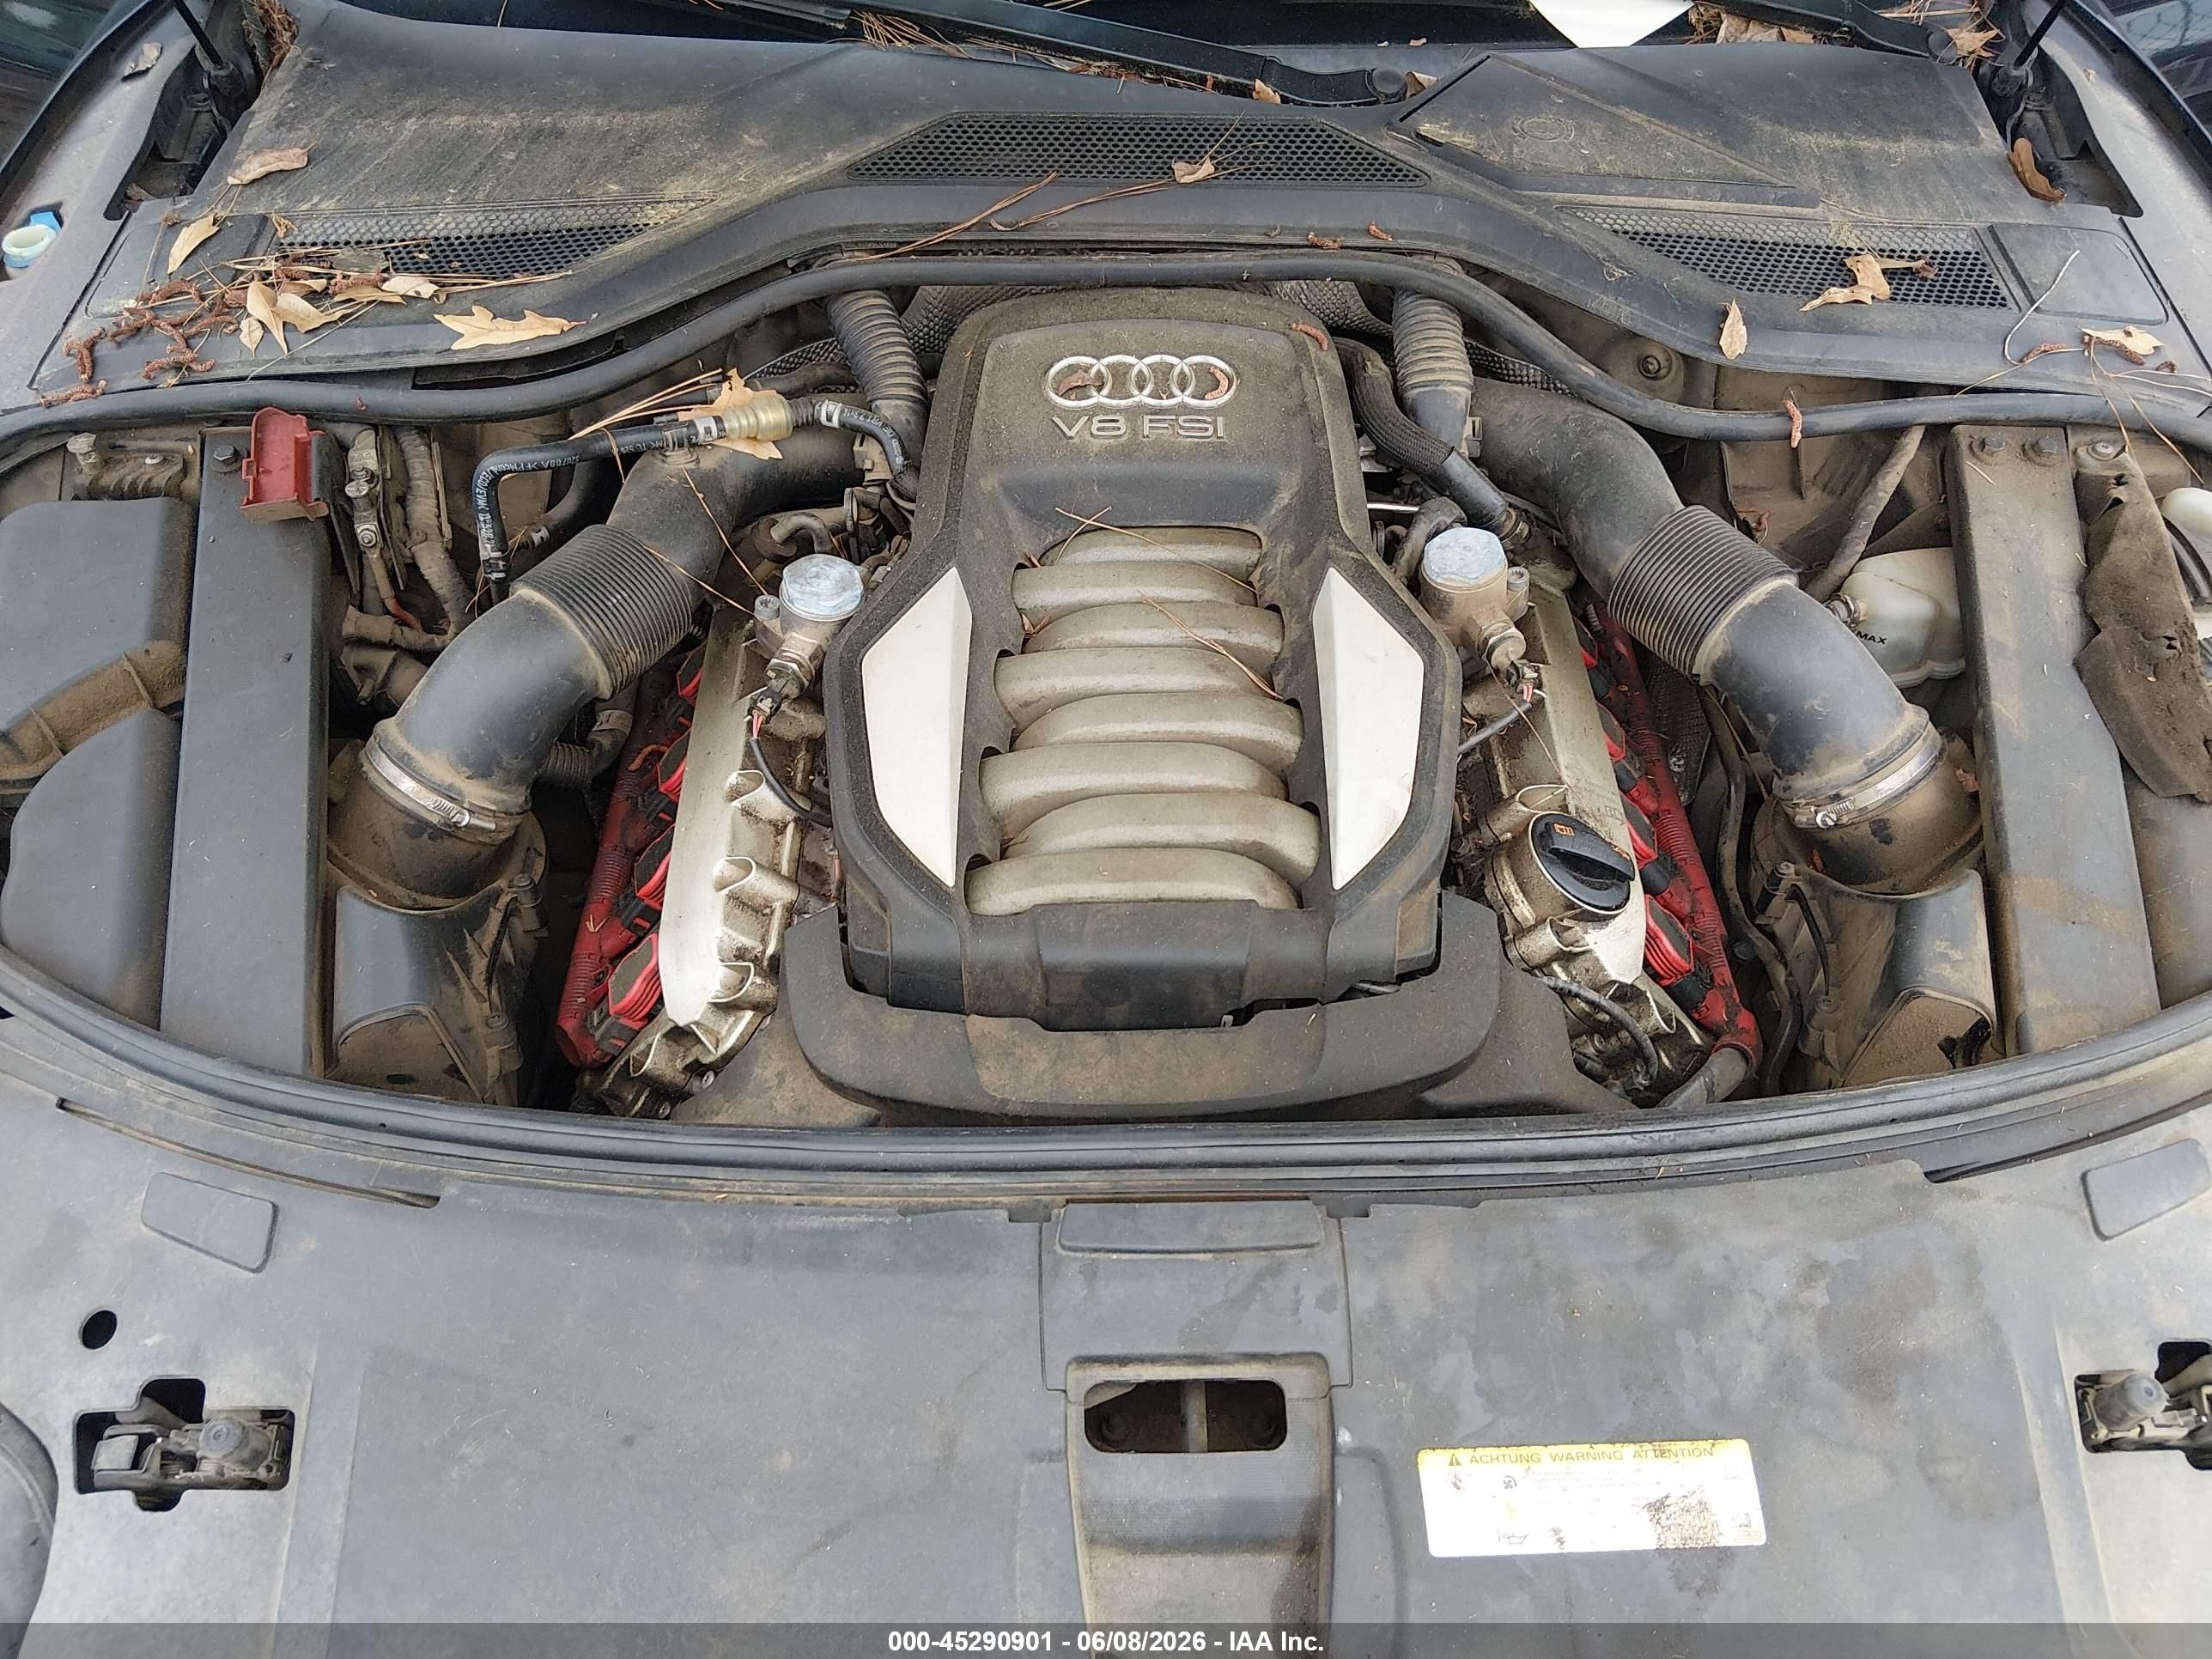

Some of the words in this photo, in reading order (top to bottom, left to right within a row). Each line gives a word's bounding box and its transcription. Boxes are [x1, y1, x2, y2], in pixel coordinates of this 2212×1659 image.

[1051, 415, 1127, 440] V8
[1142, 415, 1224, 440] FSI
[1856, 631, 1887, 645] MAX
[1469, 1451, 1541, 1465] ACHTUNG
[1549, 1449, 1624, 1462] WARNING
[1632, 1446, 1714, 1461] ATTENTION
